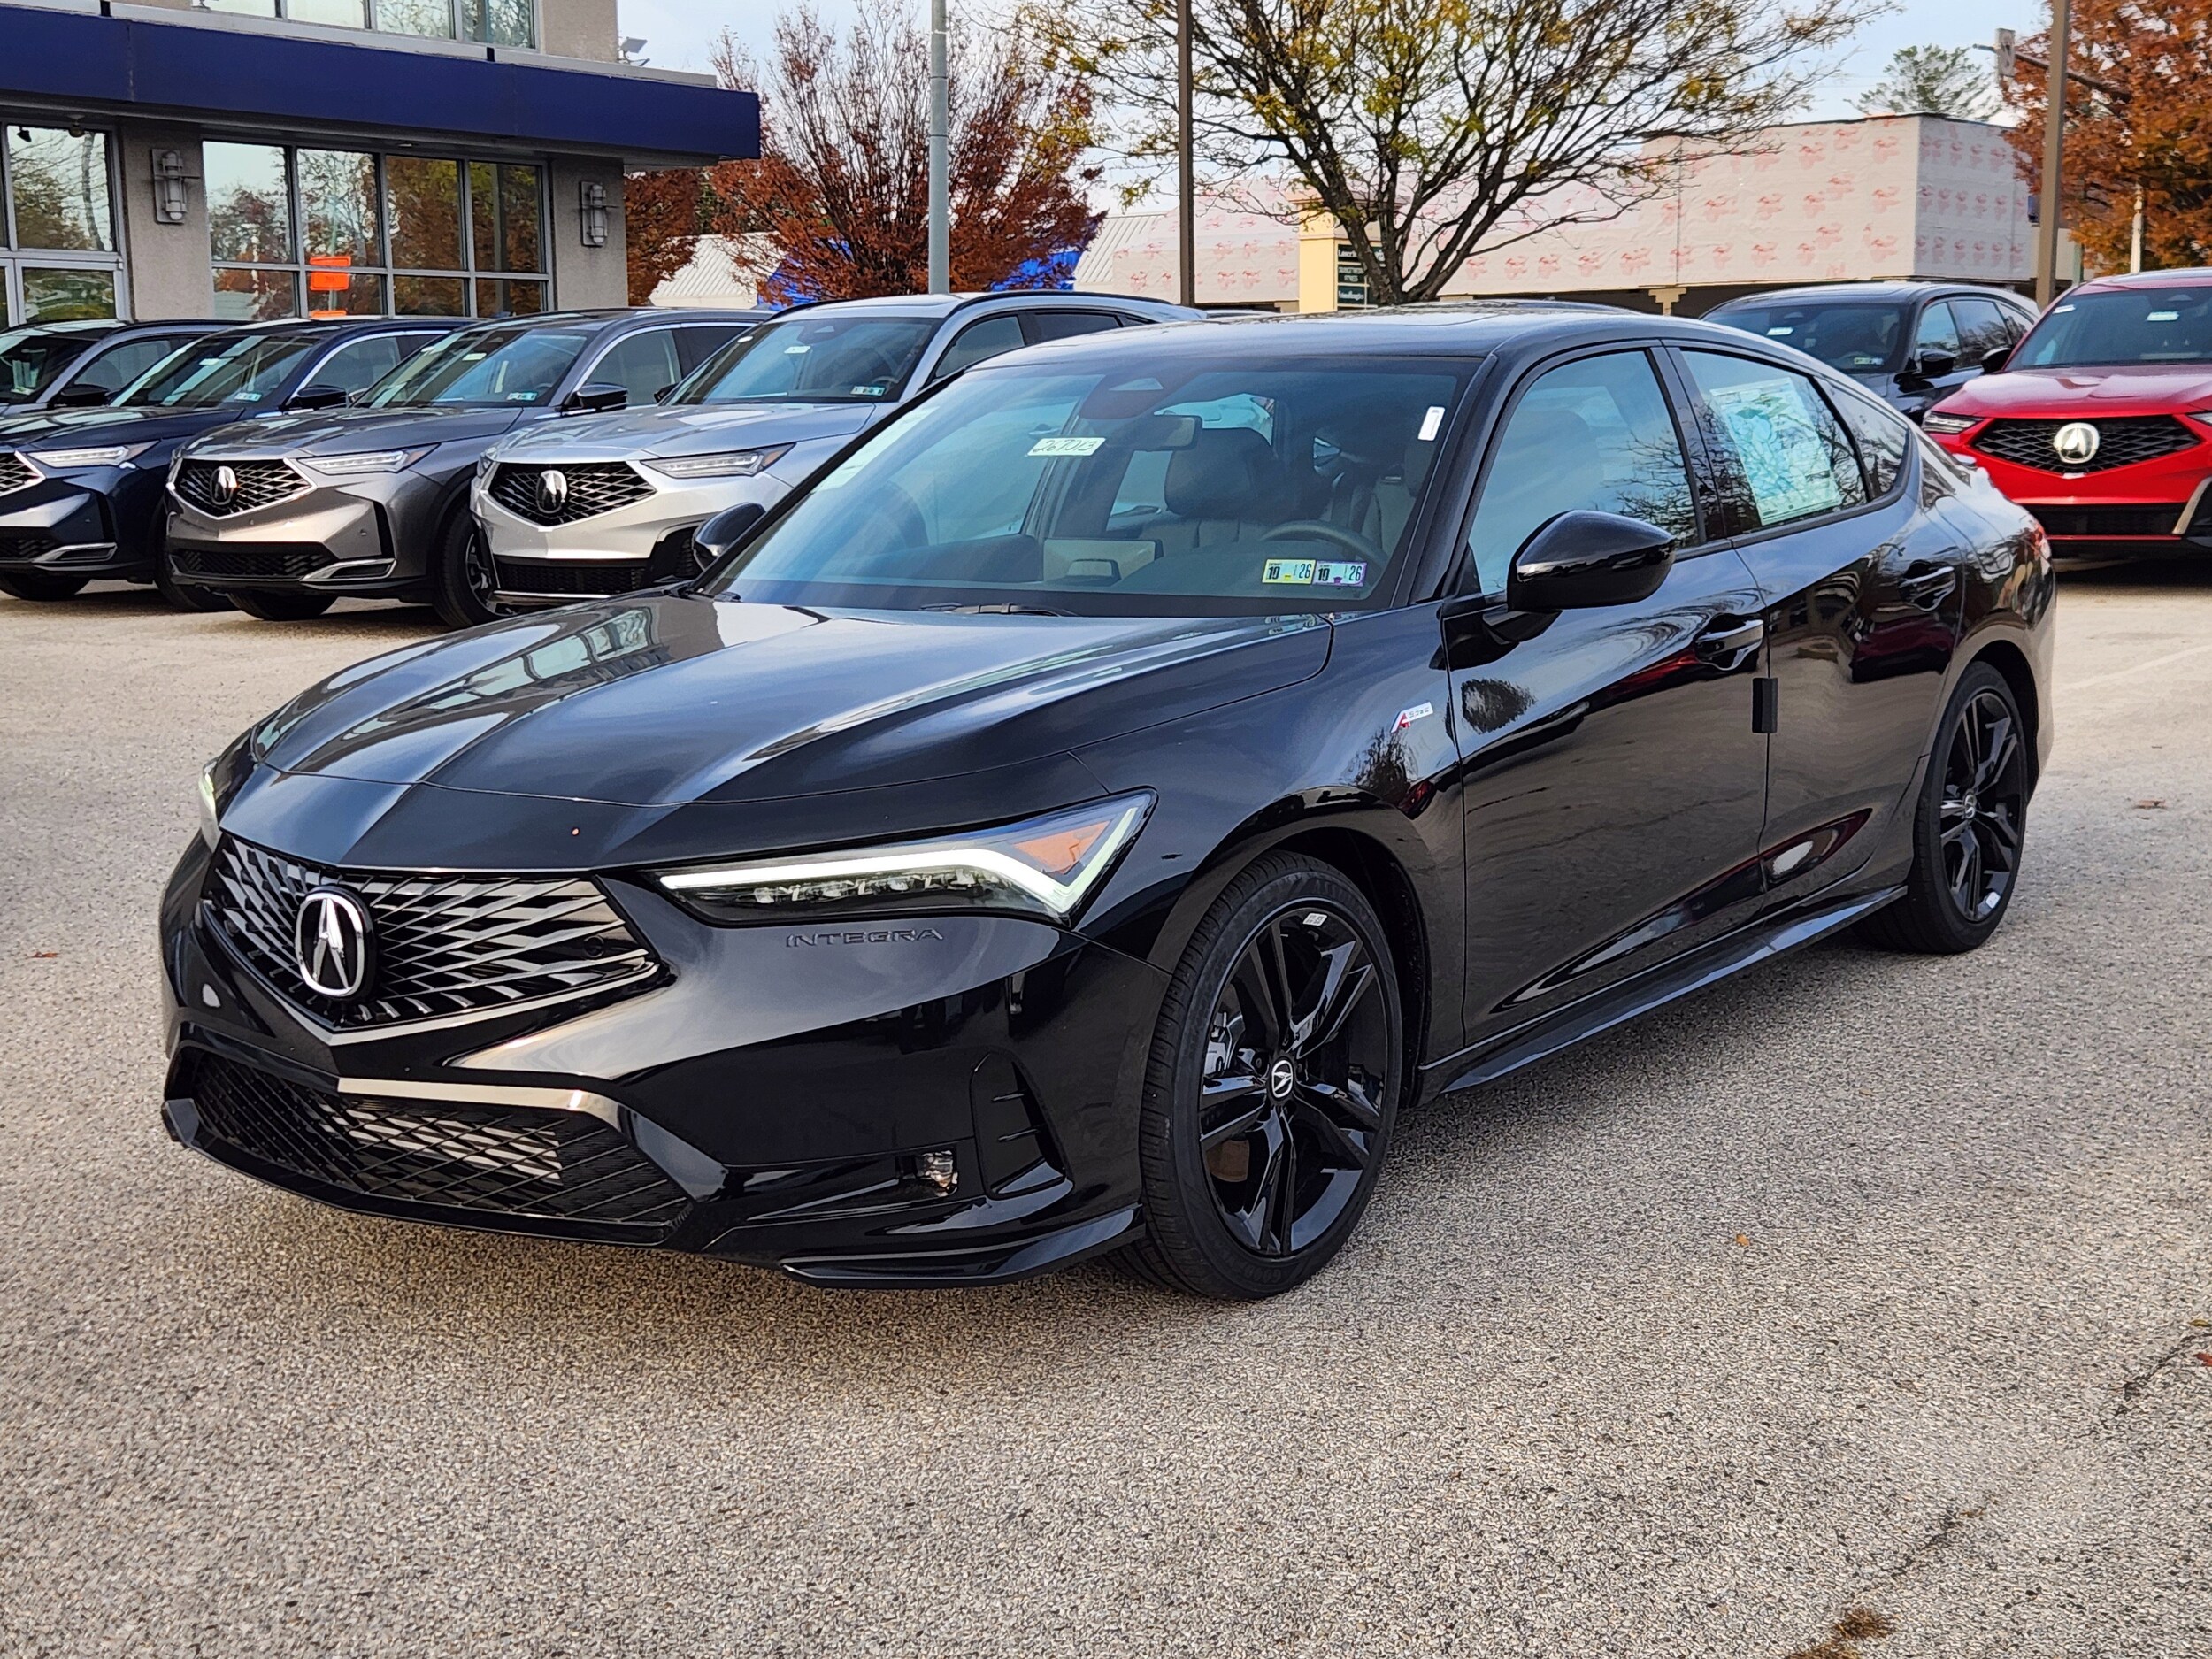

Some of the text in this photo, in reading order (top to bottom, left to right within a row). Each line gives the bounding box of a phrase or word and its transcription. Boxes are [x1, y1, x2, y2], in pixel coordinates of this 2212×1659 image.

[1269, 566, 1280, 580] 10
[1298, 564, 1312, 578] 26
[1318, 568, 1330, 581] 10
[1349, 565, 1363, 581] 26
[786, 928, 944, 947] INTEGRA
